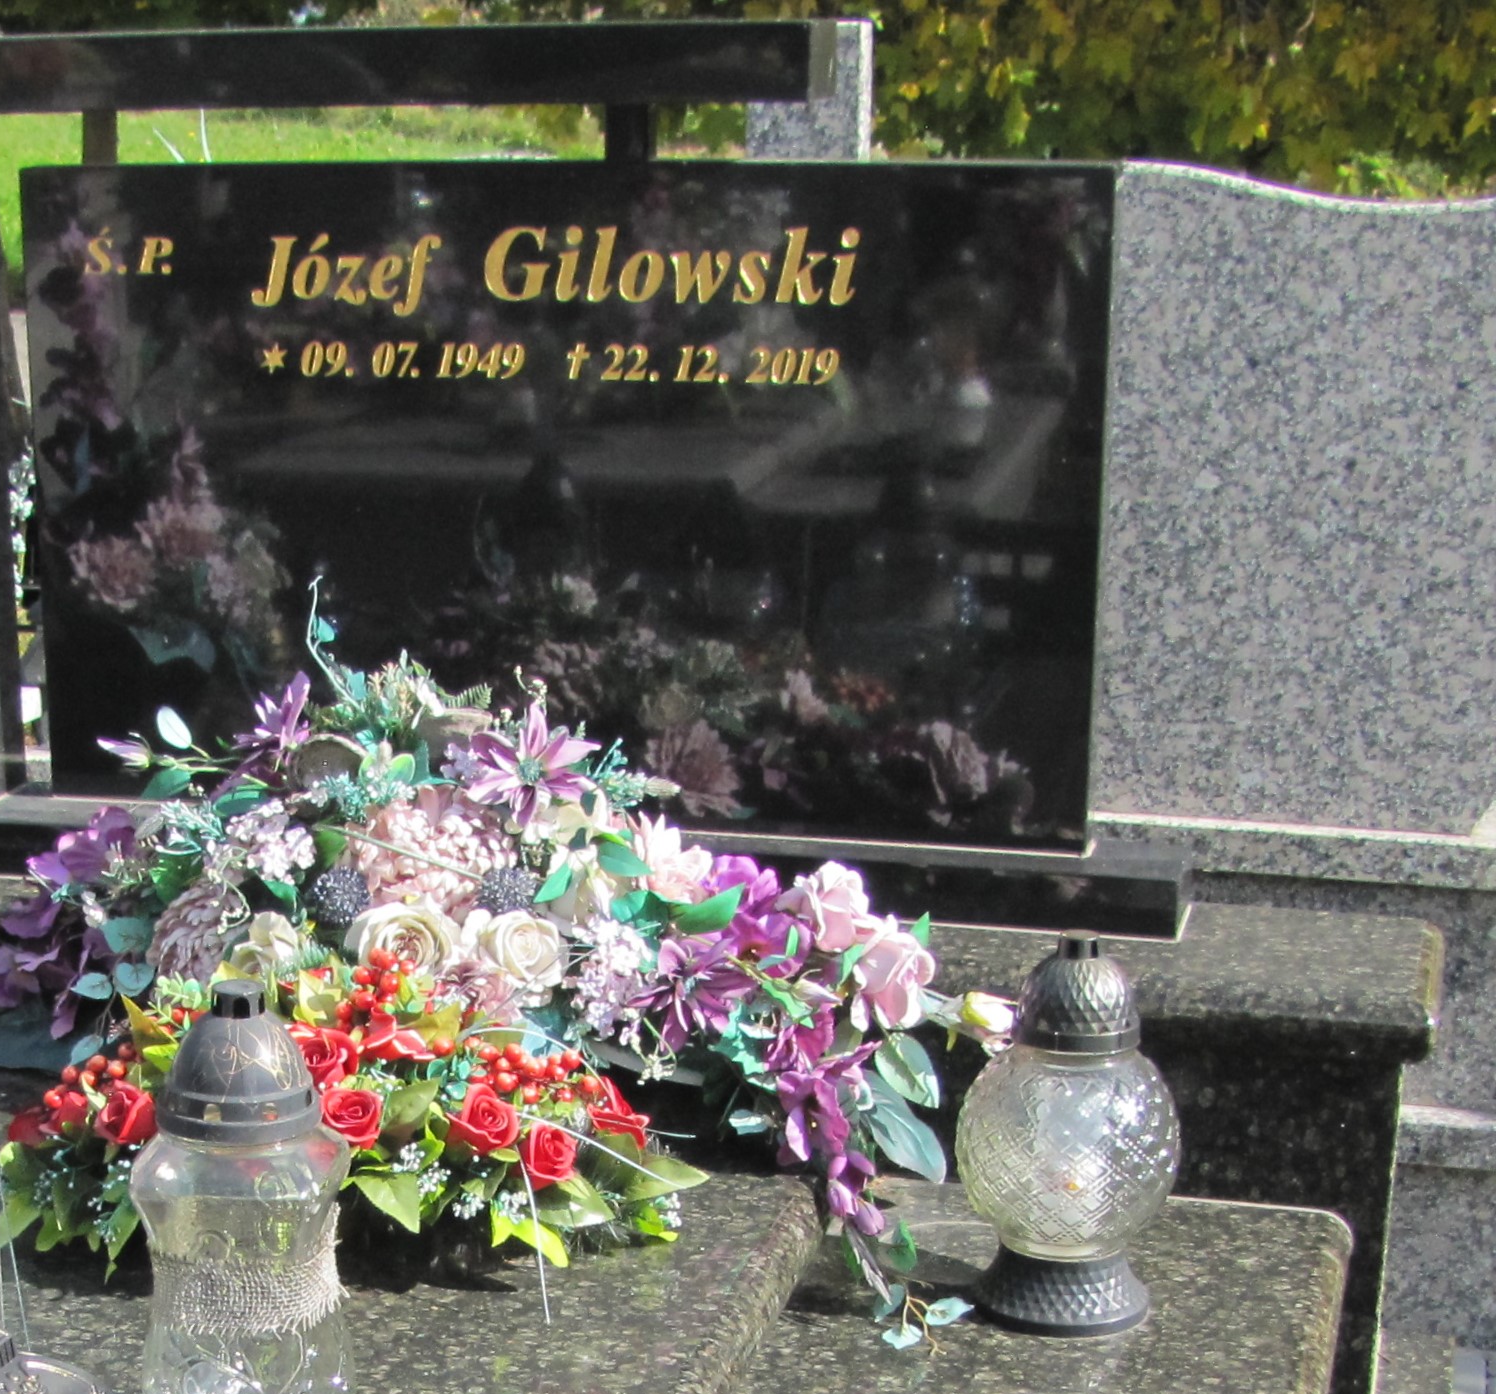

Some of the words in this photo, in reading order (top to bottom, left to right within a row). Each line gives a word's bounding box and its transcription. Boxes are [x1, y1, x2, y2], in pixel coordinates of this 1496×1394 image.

[250, 232, 442, 317] Józef
[483, 224, 861, 306] Gilowski
[300, 341, 354, 378] 09.
[372, 341, 421, 379] 07.
[435, 341, 526, 381] 1949
[600, 343, 661, 383] 22.
[673, 344, 730, 384] 12.
[744, 346, 841, 386] 2019
